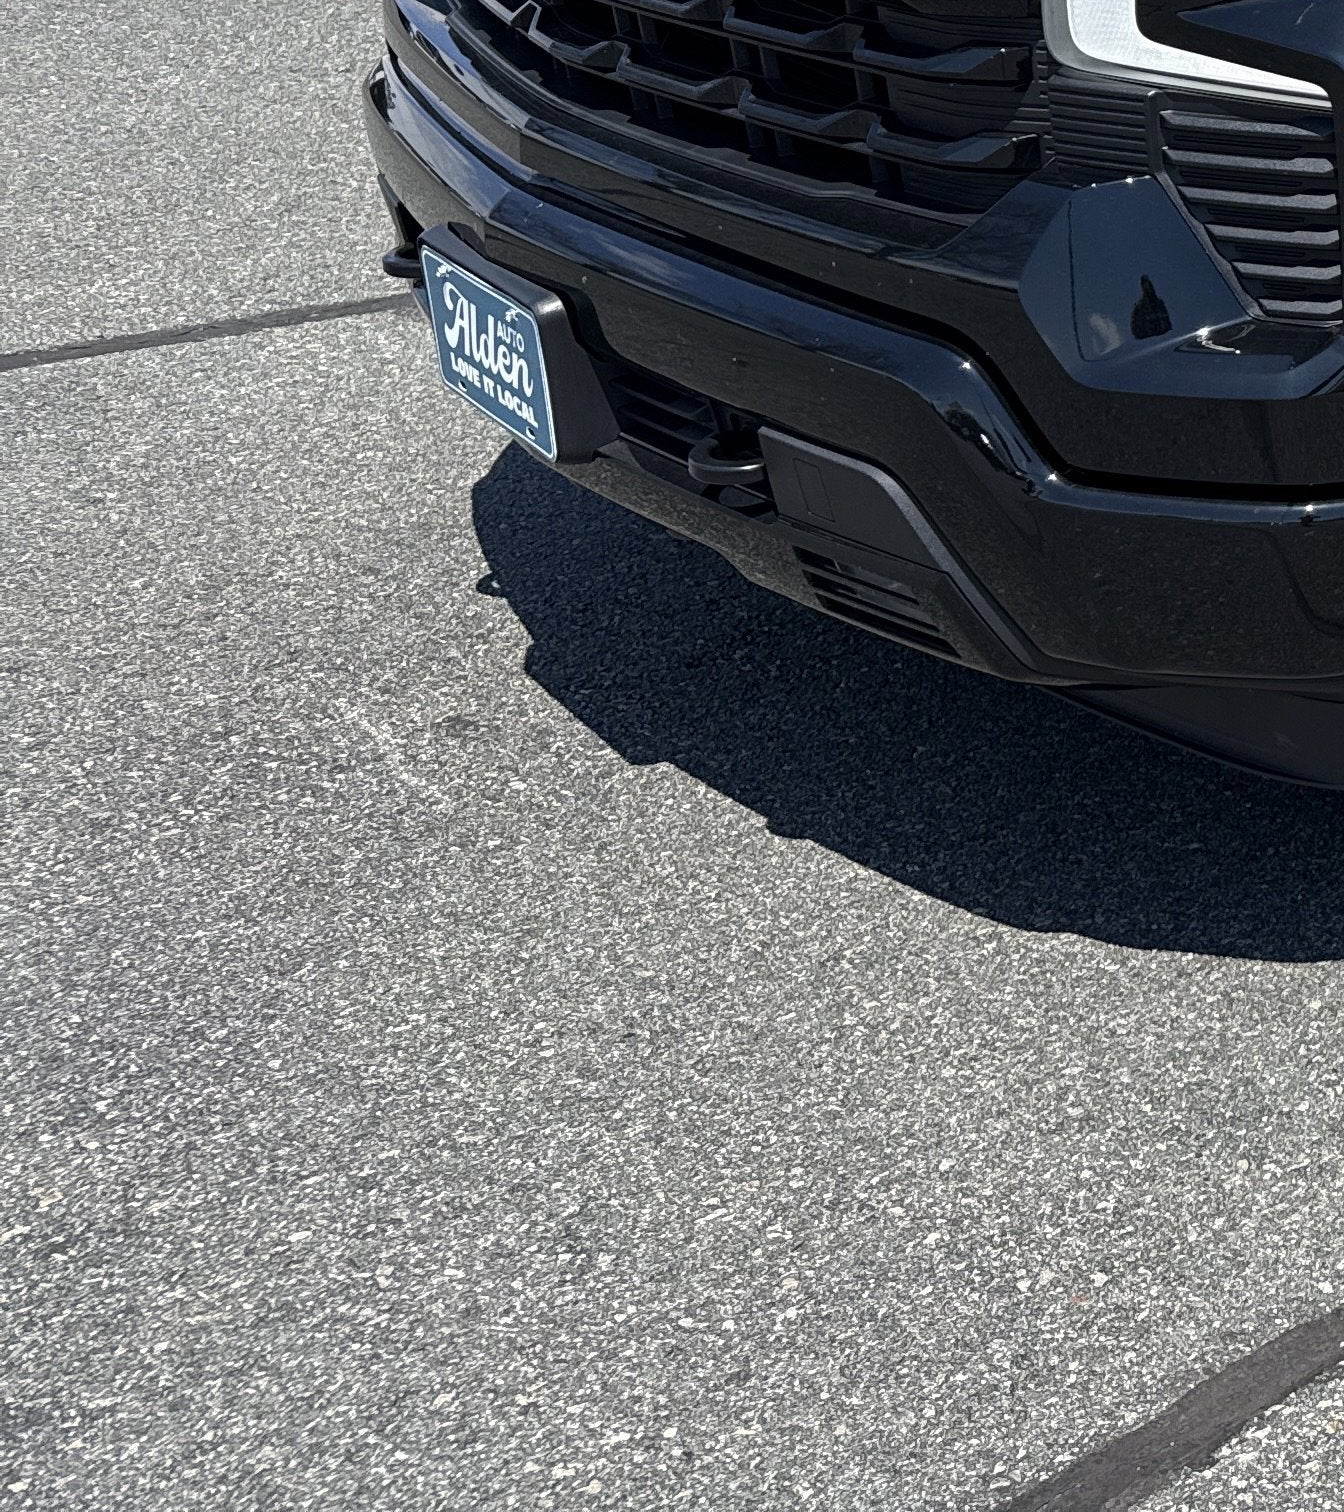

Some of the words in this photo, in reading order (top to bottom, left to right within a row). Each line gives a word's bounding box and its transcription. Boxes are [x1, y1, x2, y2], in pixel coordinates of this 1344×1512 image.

[442, 281, 534, 398] Alden
[496, 319, 525, 353] AUTO
[450, 351, 482, 386] LOVE
[482, 375, 496, 399] IT
[497, 383, 539, 430] LOCAL
